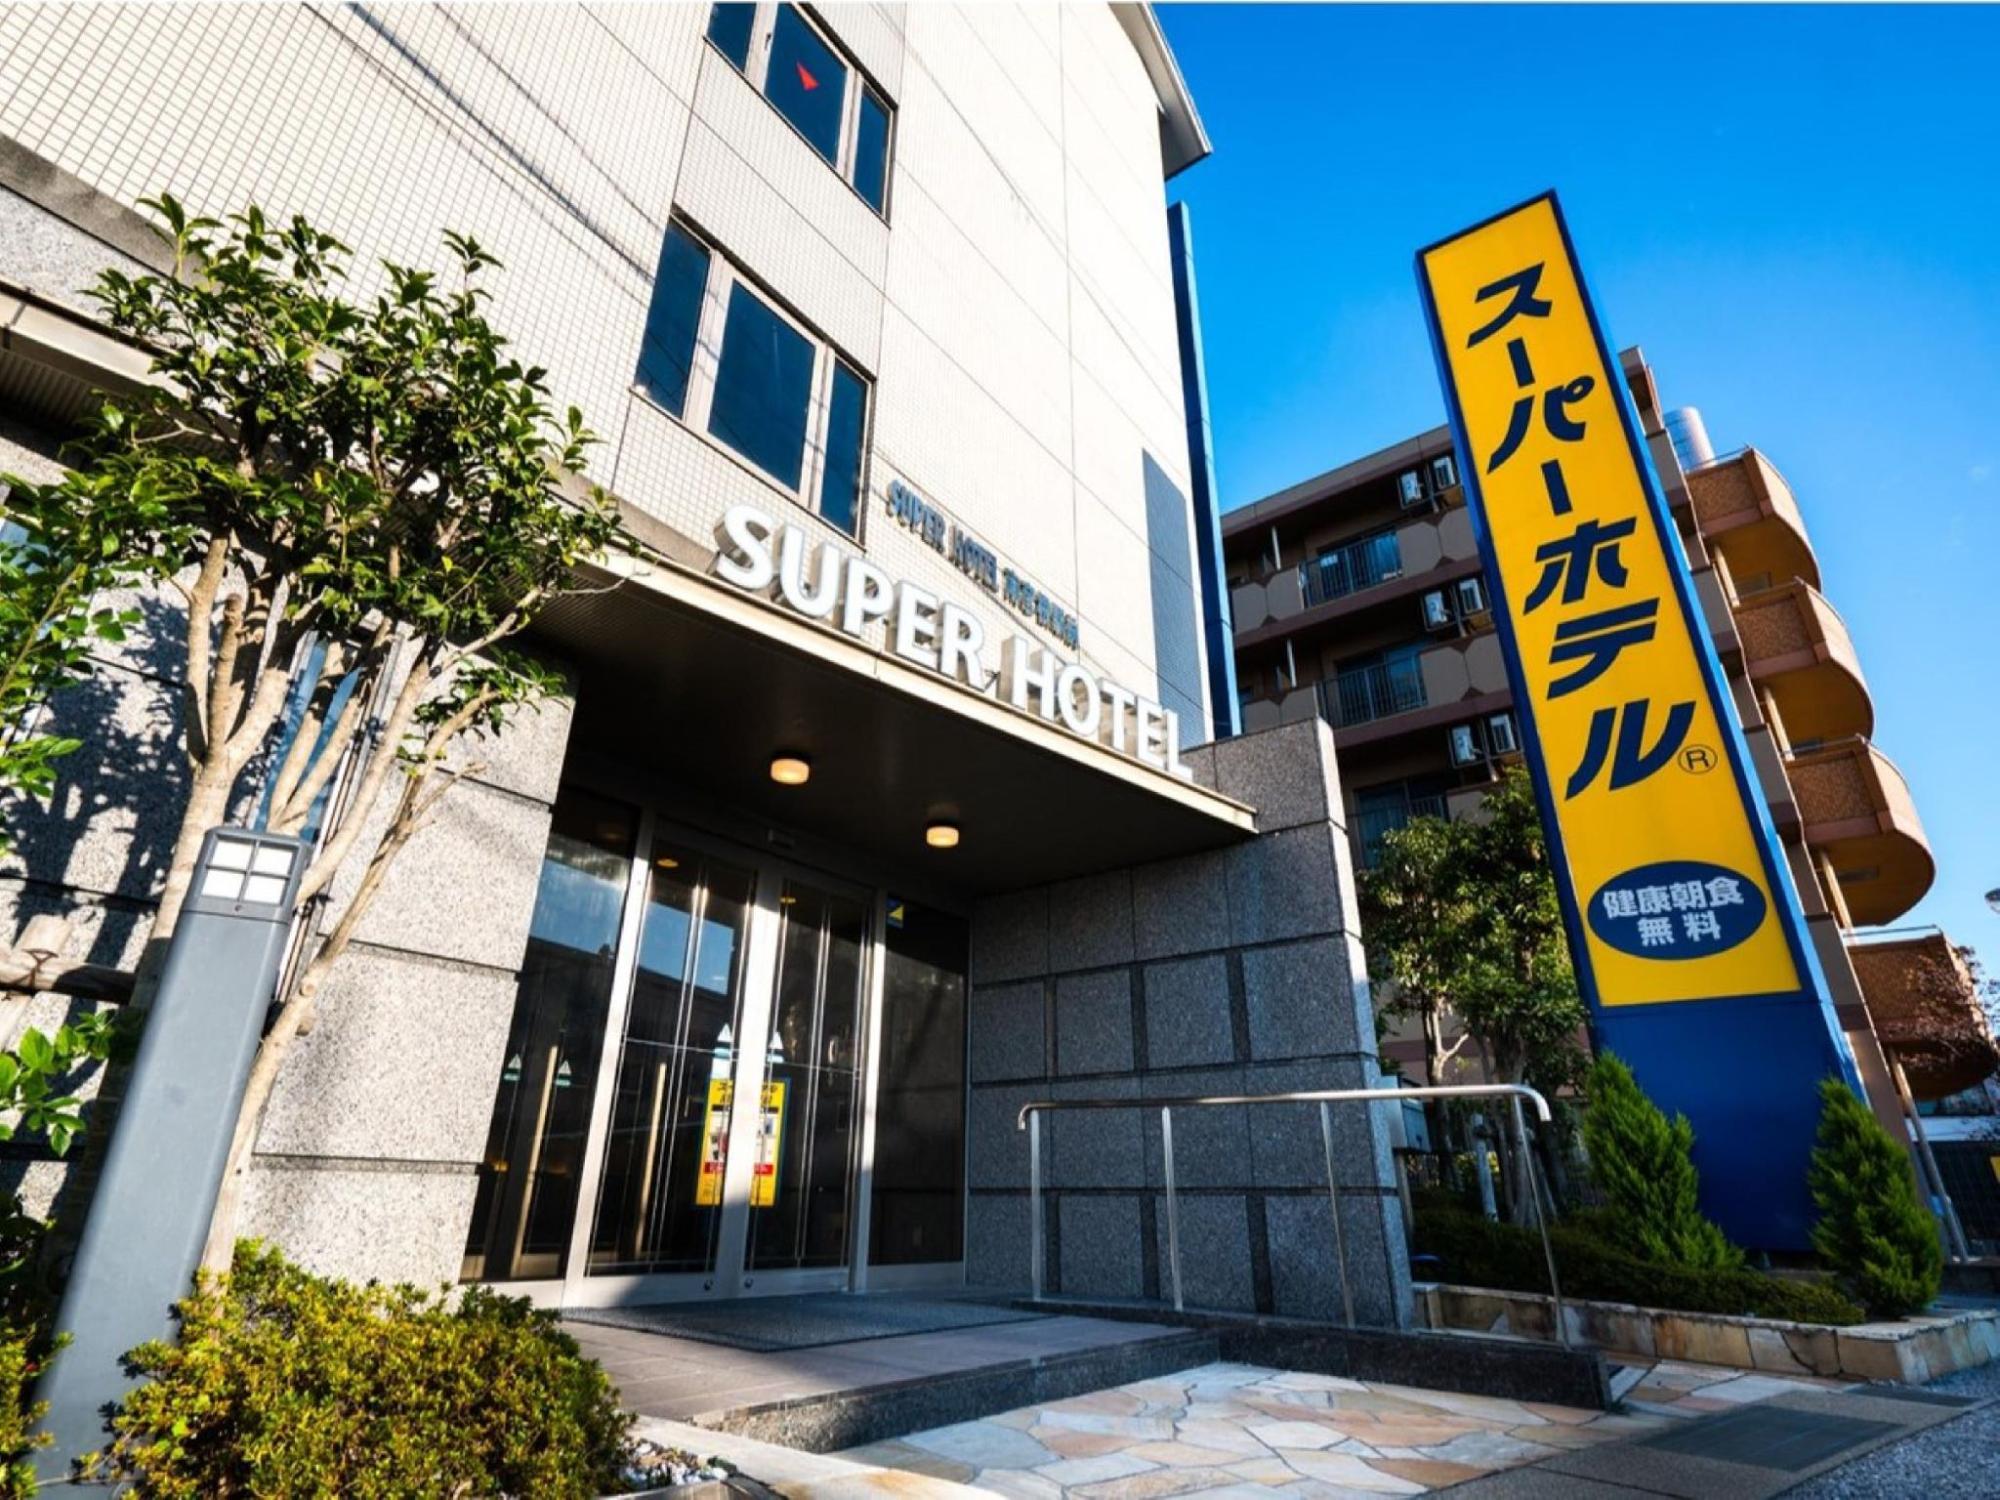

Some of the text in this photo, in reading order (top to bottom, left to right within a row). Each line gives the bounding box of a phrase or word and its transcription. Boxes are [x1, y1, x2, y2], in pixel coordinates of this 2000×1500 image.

[887, 480, 998, 594] SUPER HOTEL
[1467, 260, 1697, 801] スーパーホテル
[714, 503, 986, 693] SUPER
[1004, 634, 1192, 782] HOTEL
[1602, 876, 1745, 919] 健康朝食
[1637, 910, 1722, 947] 無料
